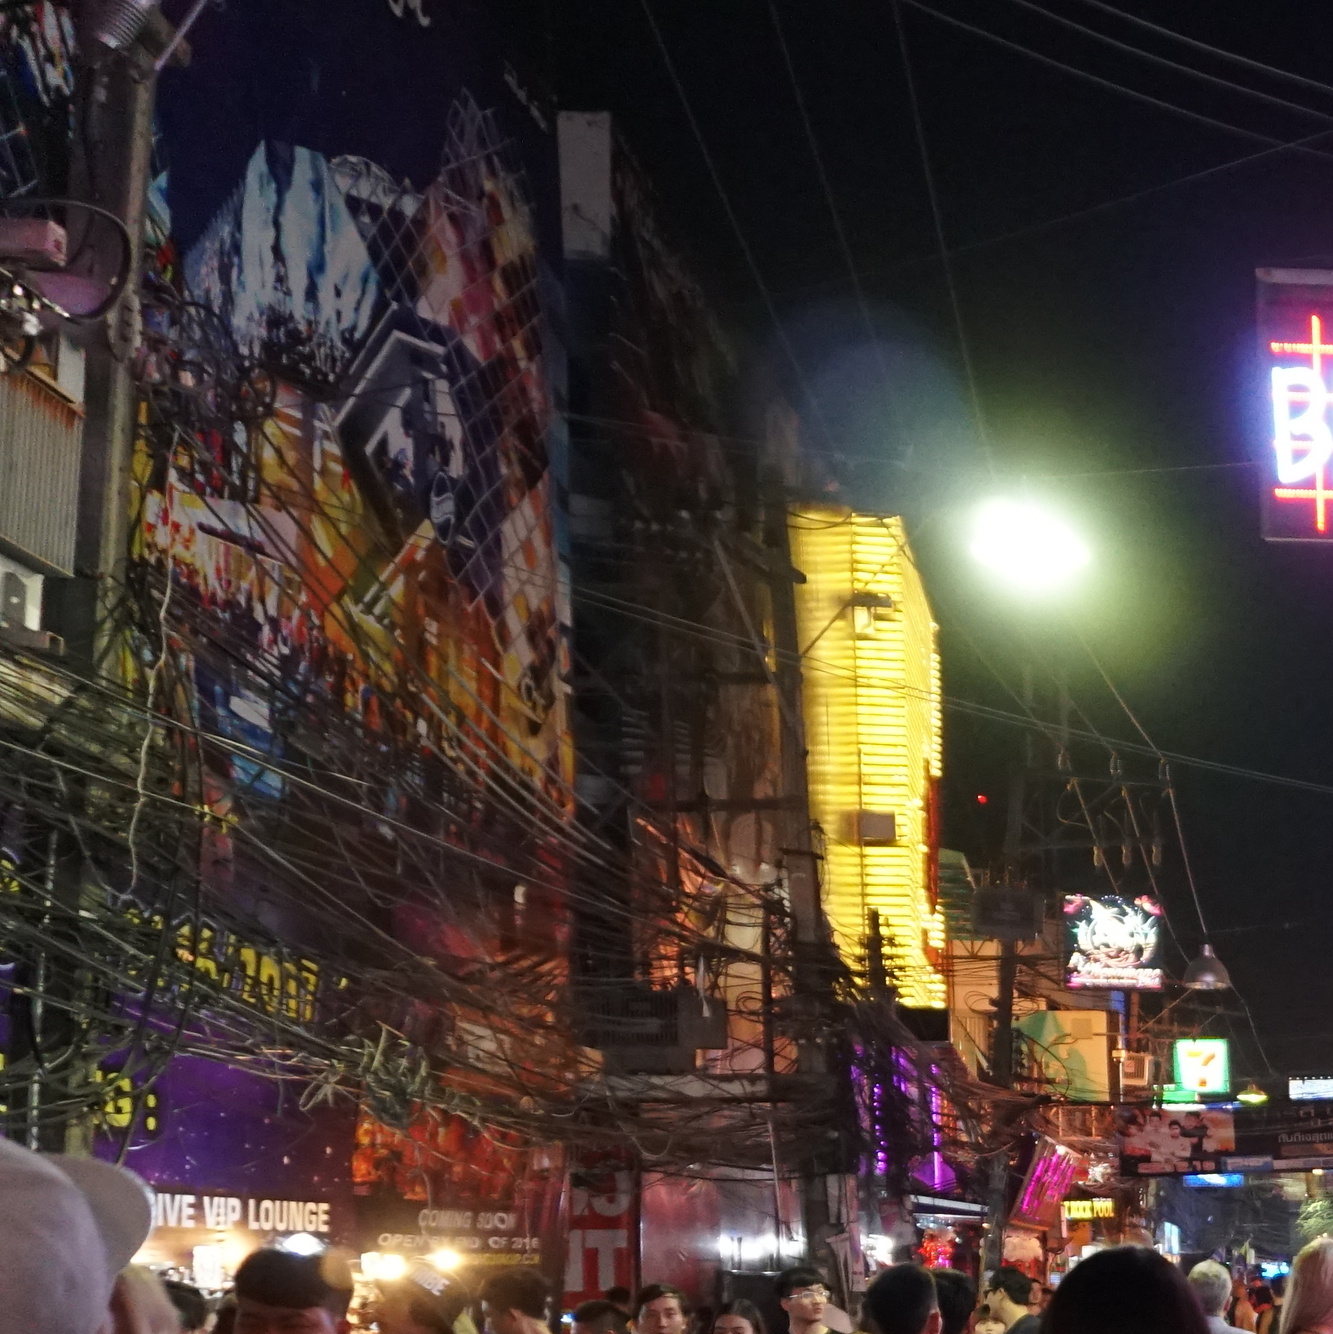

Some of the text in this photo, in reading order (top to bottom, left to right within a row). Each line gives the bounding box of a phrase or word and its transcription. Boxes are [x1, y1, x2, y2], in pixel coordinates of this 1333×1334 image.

[202, 1195, 243, 1230] VIP
[247, 1198, 331, 1233] LOUNGE
[417, 1208, 517, 1231] COMING SOON
[1093, 1200, 1115, 1218] POOL
